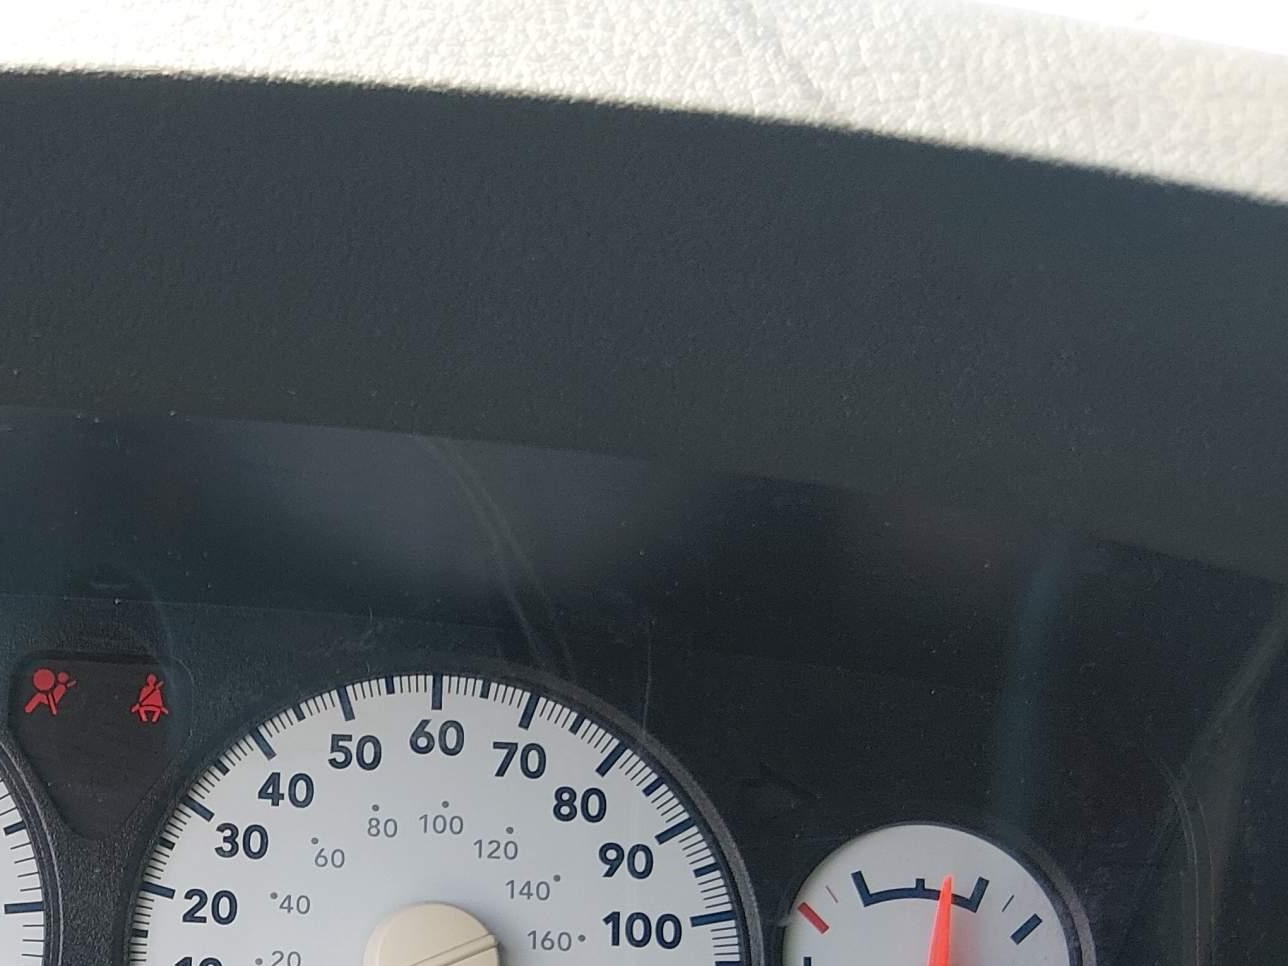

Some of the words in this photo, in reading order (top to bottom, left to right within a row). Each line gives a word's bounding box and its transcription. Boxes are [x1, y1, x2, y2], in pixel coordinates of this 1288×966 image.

[327, 733, 382, 771] 50
[409, 719, 465, 757] 60
[492, 741, 547, 780] 70
[257, 771, 315, 809] 40
[552, 786, 607, 824] 80
[214, 822, 269, 860] 30
[367, 817, 398, 838] 80
[419, 814, 464, 835] 100
[314, 847, 345, 869] 60
[473, 839, 519, 861] 120
[598, 842, 654, 880] 90
[182, 888, 238, 926] 20
[279, 894, 311, 915] 40
[505, 879, 551, 901] 140
[527, 930, 572, 952] 160
[602, 911, 683, 950] 100
